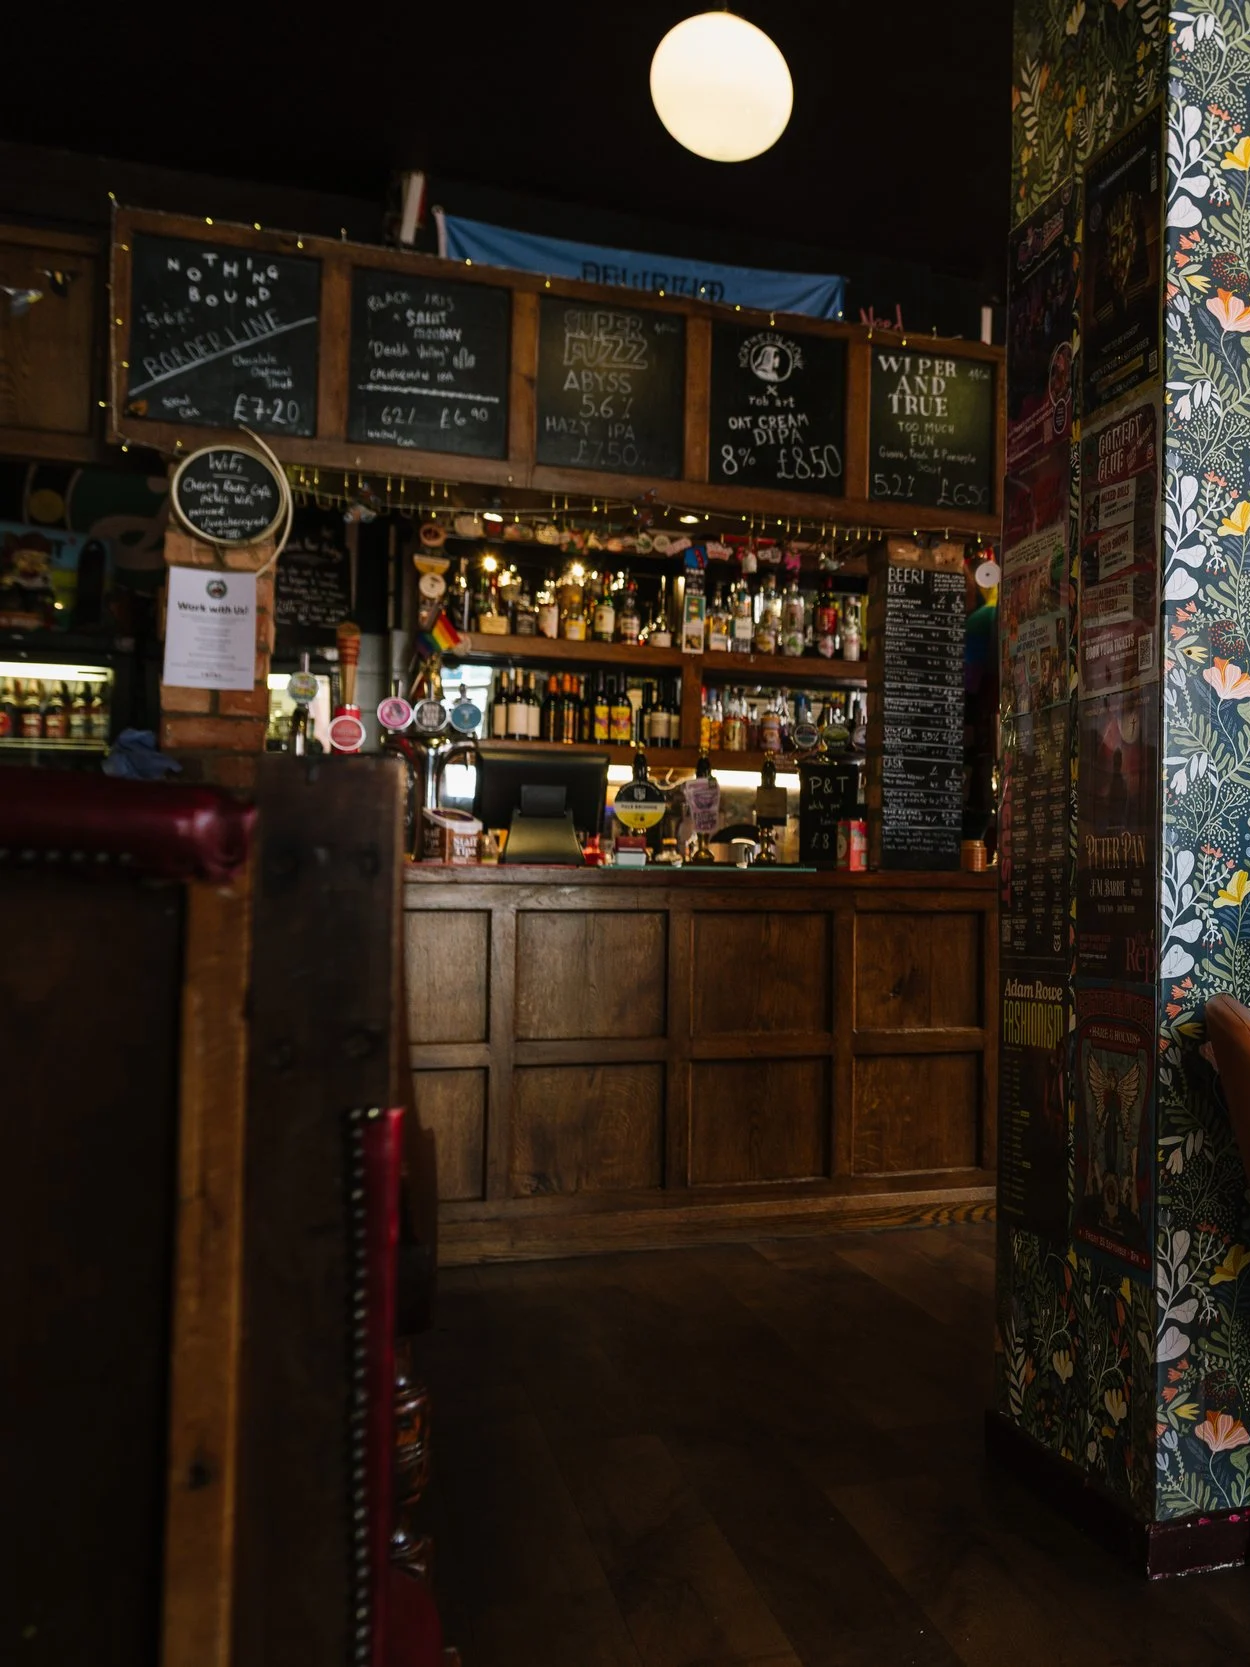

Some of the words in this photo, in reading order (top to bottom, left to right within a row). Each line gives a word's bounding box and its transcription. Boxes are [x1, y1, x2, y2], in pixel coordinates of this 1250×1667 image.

[167, 252, 280, 285] NOTHING
[188, 285, 271, 308] BOUND
[564, 309, 644, 340] SUPER
[143, 308, 283, 381] BORDERLINE
[563, 332, 649, 370] FUZZ
[878, 354, 958, 378] WIPER
[563, 369, 632, 393] ABYSS
[895, 375, 947, 397] AND
[233, 393, 301, 425] £7.20
[887, 393, 949, 417] TRUE
[545, 416, 591, 435] HAZY
[608, 424, 635, 441] IPA
[728, 415, 753, 430] OAT
[758, 412, 810, 430] CREAM
[897, 421, 920, 433] TOO
[924, 421, 955, 435] MUCH
[752, 427, 804, 446] DIPA
[909, 433, 935, 446] FUN
[1099, 412, 1143, 456] COMEDY
[721, 443, 756, 476] 8%
[776, 443, 843, 480] £8.50
[1098, 447, 1125, 482] CLUB
[888, 567, 925, 585] BEER!
[1113, 633, 1135, 656] TICKETS
[883, 759, 904, 769] CASK
[1085, 833, 1120, 869] PETER
[1121, 831, 1146, 869] PAN
[1104, 878, 1126, 897] BARRIE
[1126, 936, 1156, 984] Rep
[1004, 978, 1035, 1000] Adam
[1035, 980, 1063, 1002] Rowe
[1003, 999, 1065, 1050] FASHIONISM
